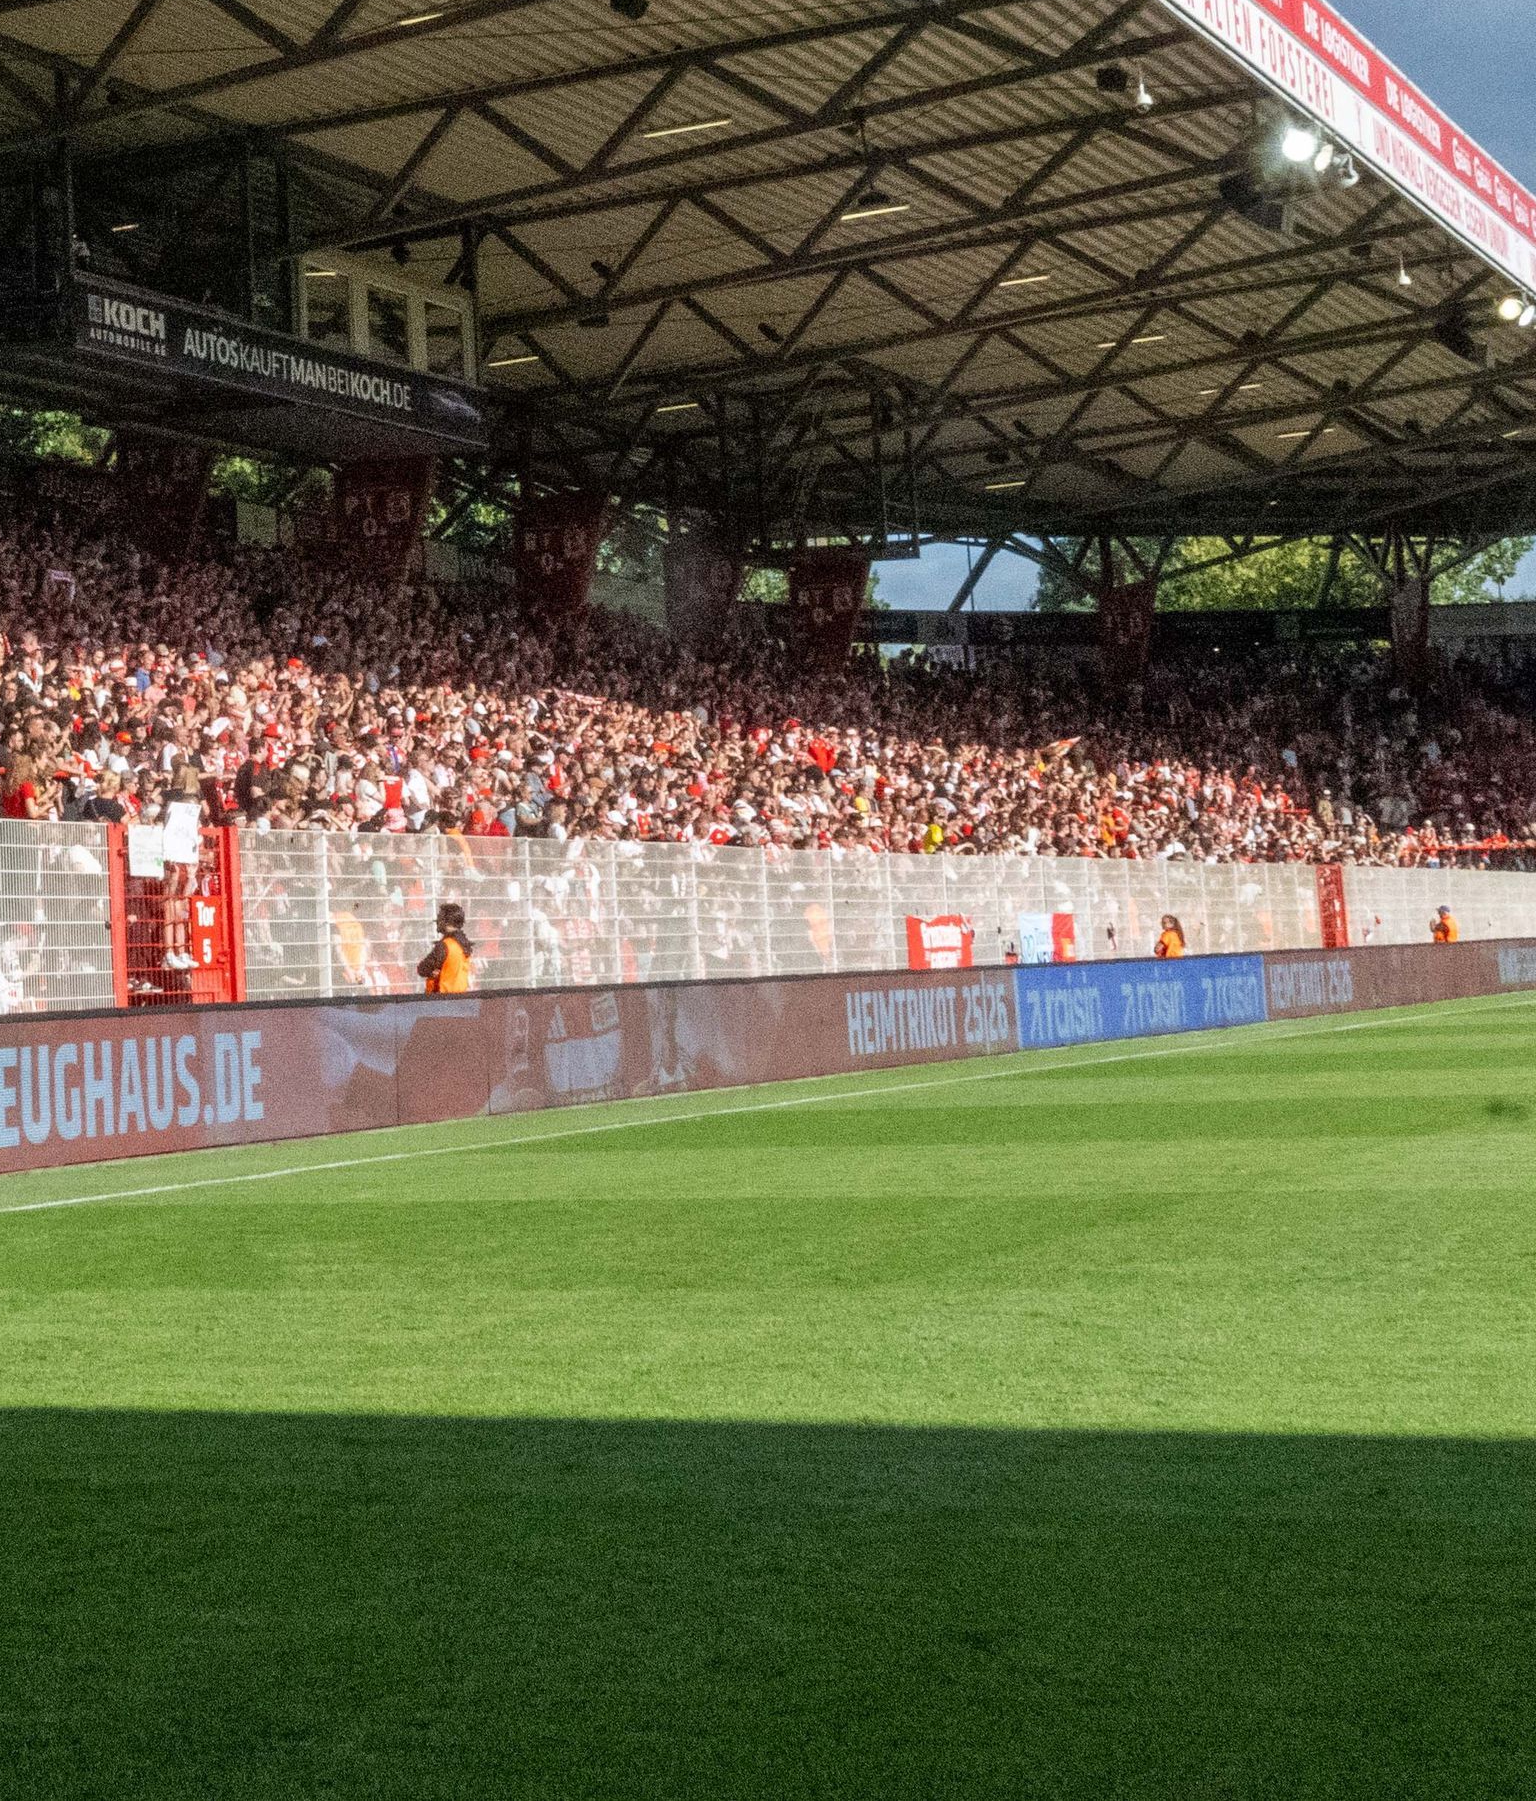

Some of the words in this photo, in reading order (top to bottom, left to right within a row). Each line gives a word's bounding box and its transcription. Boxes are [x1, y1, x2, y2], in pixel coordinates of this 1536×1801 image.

[103, 297, 167, 341] KOCH
[195, 900, 216, 927] Tor
[201, 938, 212, 964] 5
[845, 991, 957, 1056] HEIMTRIKOT
